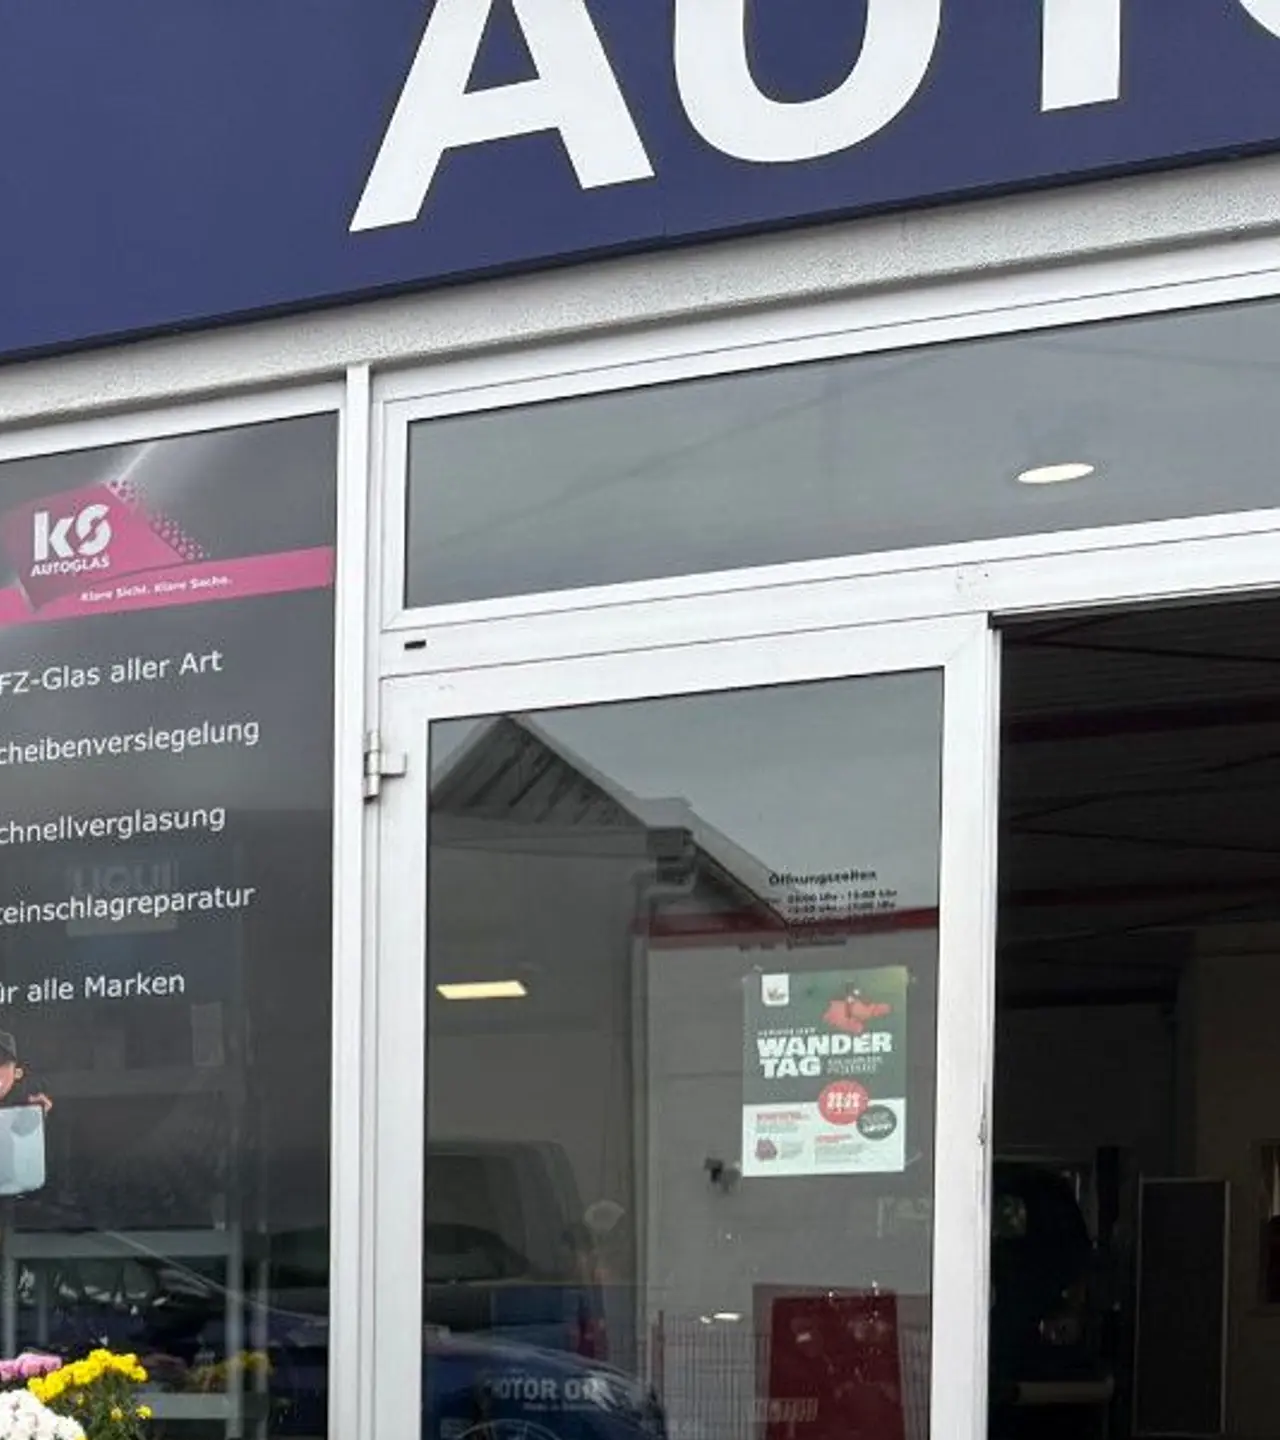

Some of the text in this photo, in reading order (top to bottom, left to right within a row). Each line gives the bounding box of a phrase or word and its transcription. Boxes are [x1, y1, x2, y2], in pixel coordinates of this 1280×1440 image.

[349, 0, 1280, 232] AU
[30, 555, 110, 577] AUTOGLAS
[110, 657, 170, 683] aller
[179, 650, 223, 676] Art
[27, 978, 74, 1003] alle
[84, 971, 185, 999] Marken
[756, 1031, 893, 1058] WANDER
[759, 1056, 822, 1079] TAG
